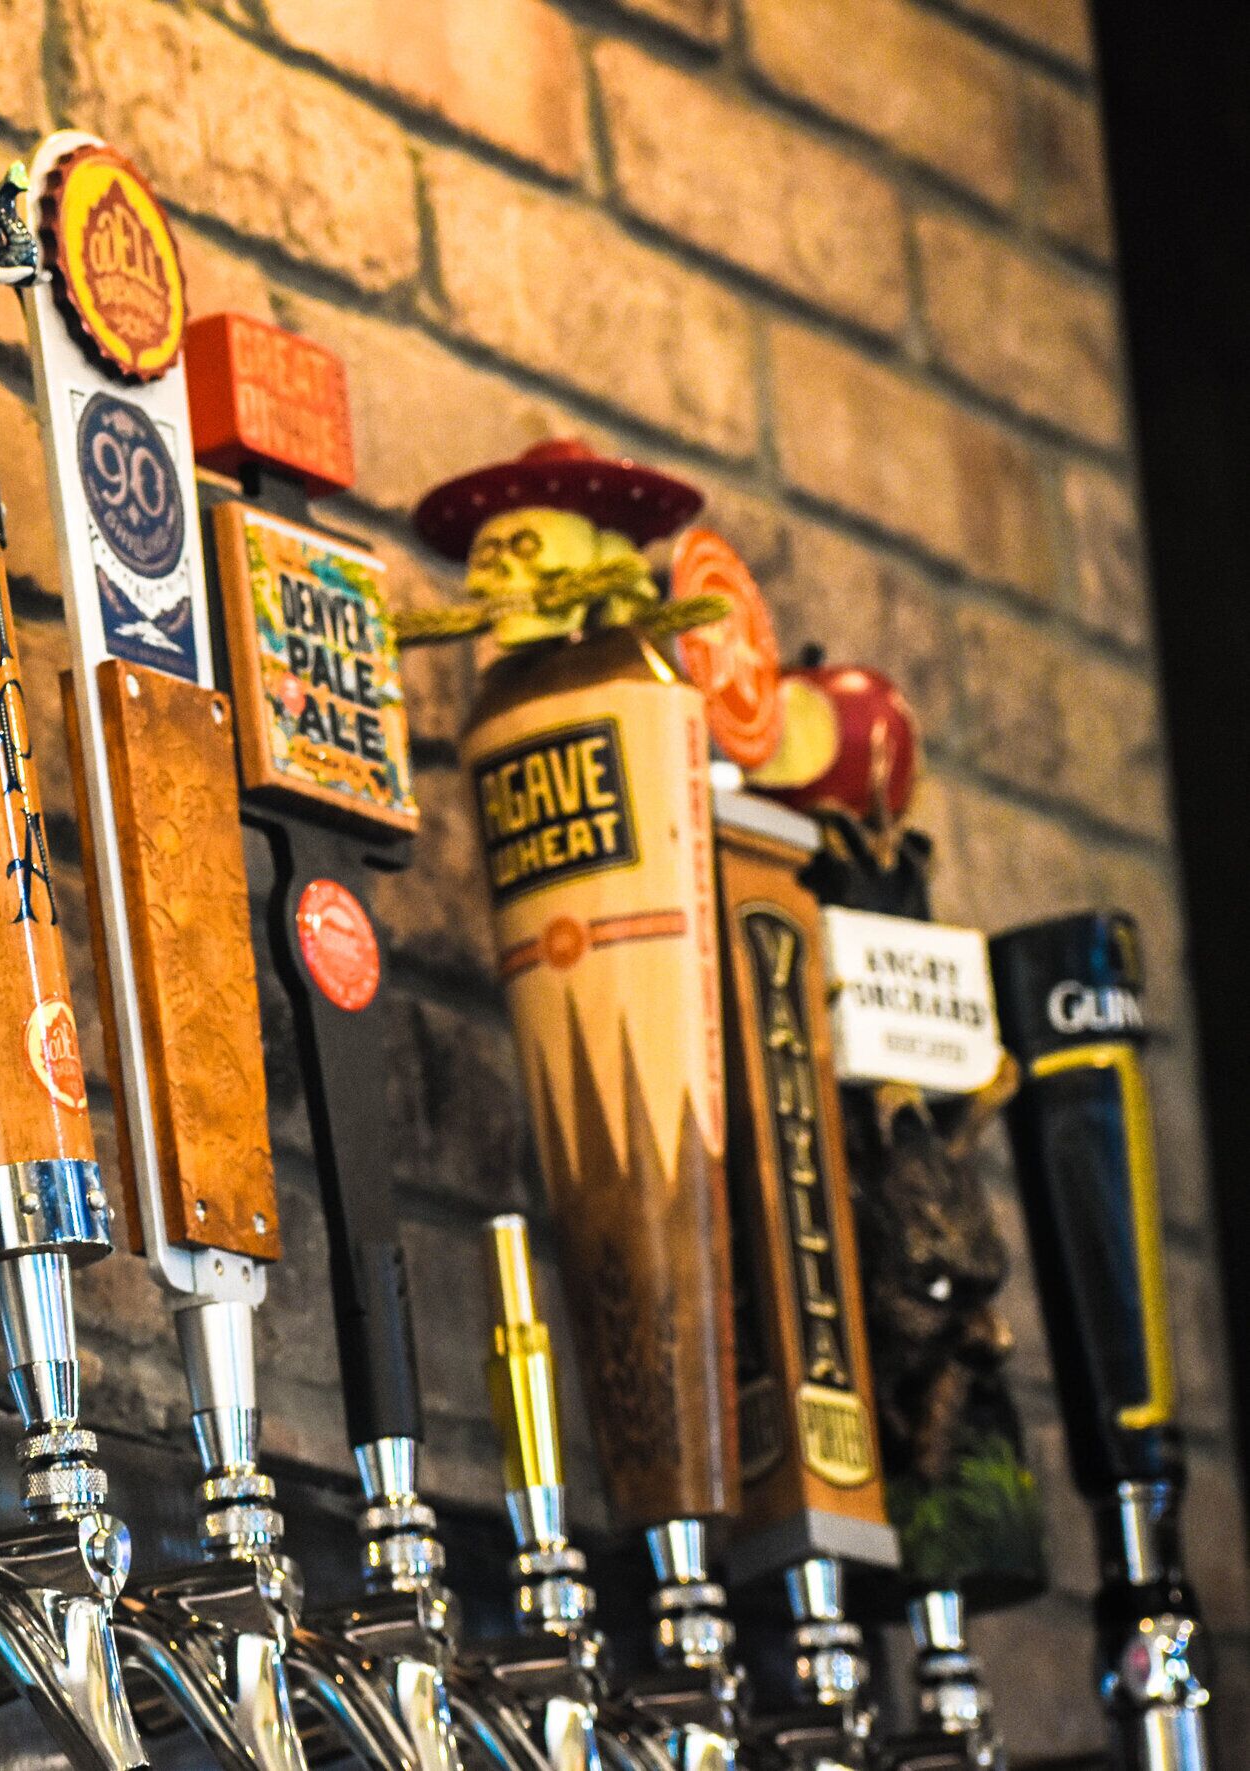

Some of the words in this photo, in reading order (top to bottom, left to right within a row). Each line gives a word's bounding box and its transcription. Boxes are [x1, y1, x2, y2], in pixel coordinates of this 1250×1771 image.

[92, 431, 166, 518] 90
[287, 633, 381, 709] PALE
[298, 694, 388, 763] ALE
